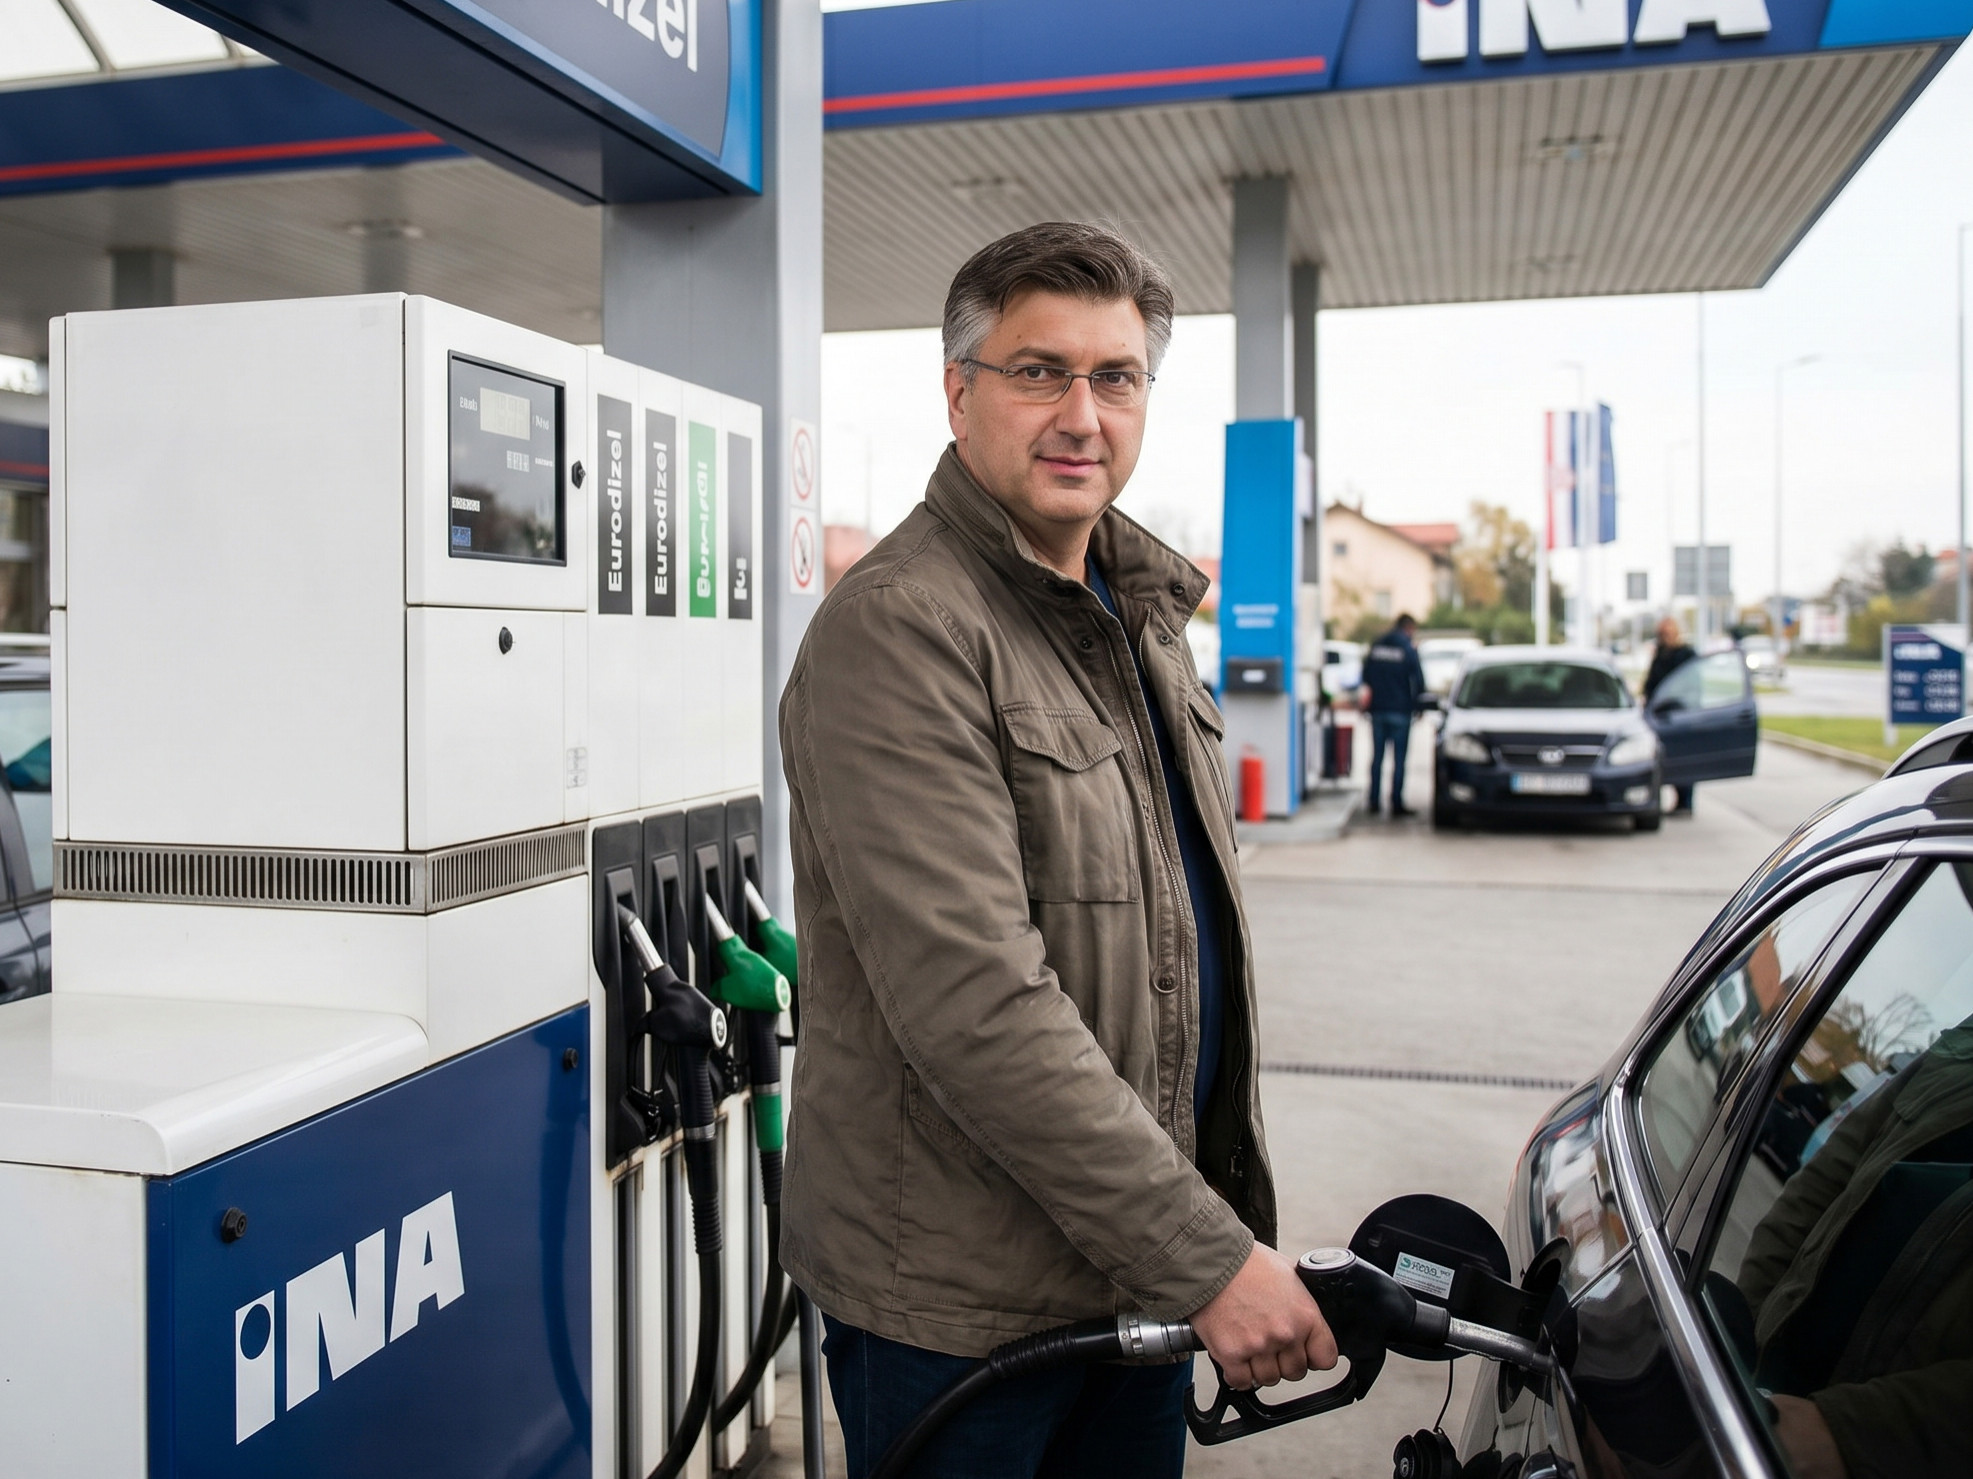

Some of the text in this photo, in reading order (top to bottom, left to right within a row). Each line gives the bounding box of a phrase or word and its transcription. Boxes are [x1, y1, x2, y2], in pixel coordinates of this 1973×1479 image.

[607, 430, 622, 592] Eurodizel
[653, 442, 667, 595] Eurodizel
[236, 1190, 465, 1445] INA
